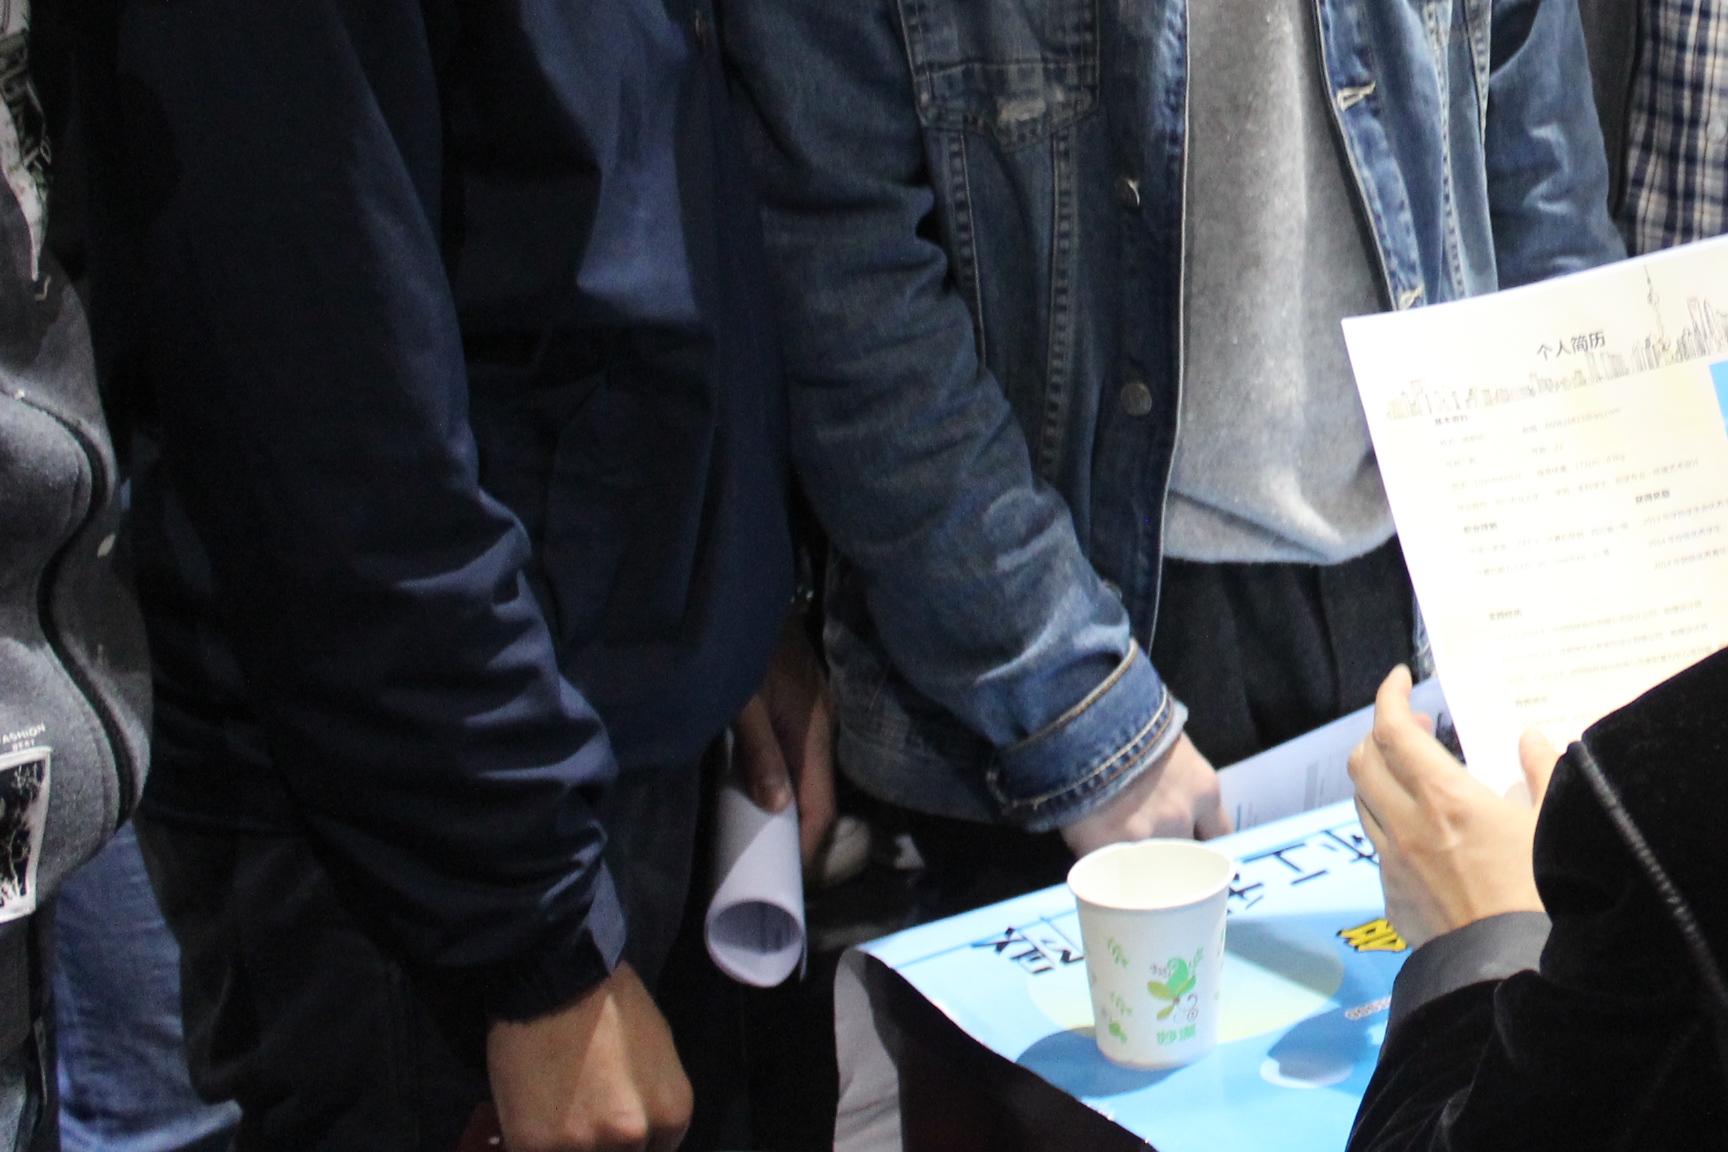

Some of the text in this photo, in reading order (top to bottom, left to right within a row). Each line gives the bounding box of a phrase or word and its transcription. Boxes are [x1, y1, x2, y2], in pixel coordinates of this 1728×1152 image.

[1537, 328, 1606, 361] 个人简历
[0, 720, 46, 745] ASHION
